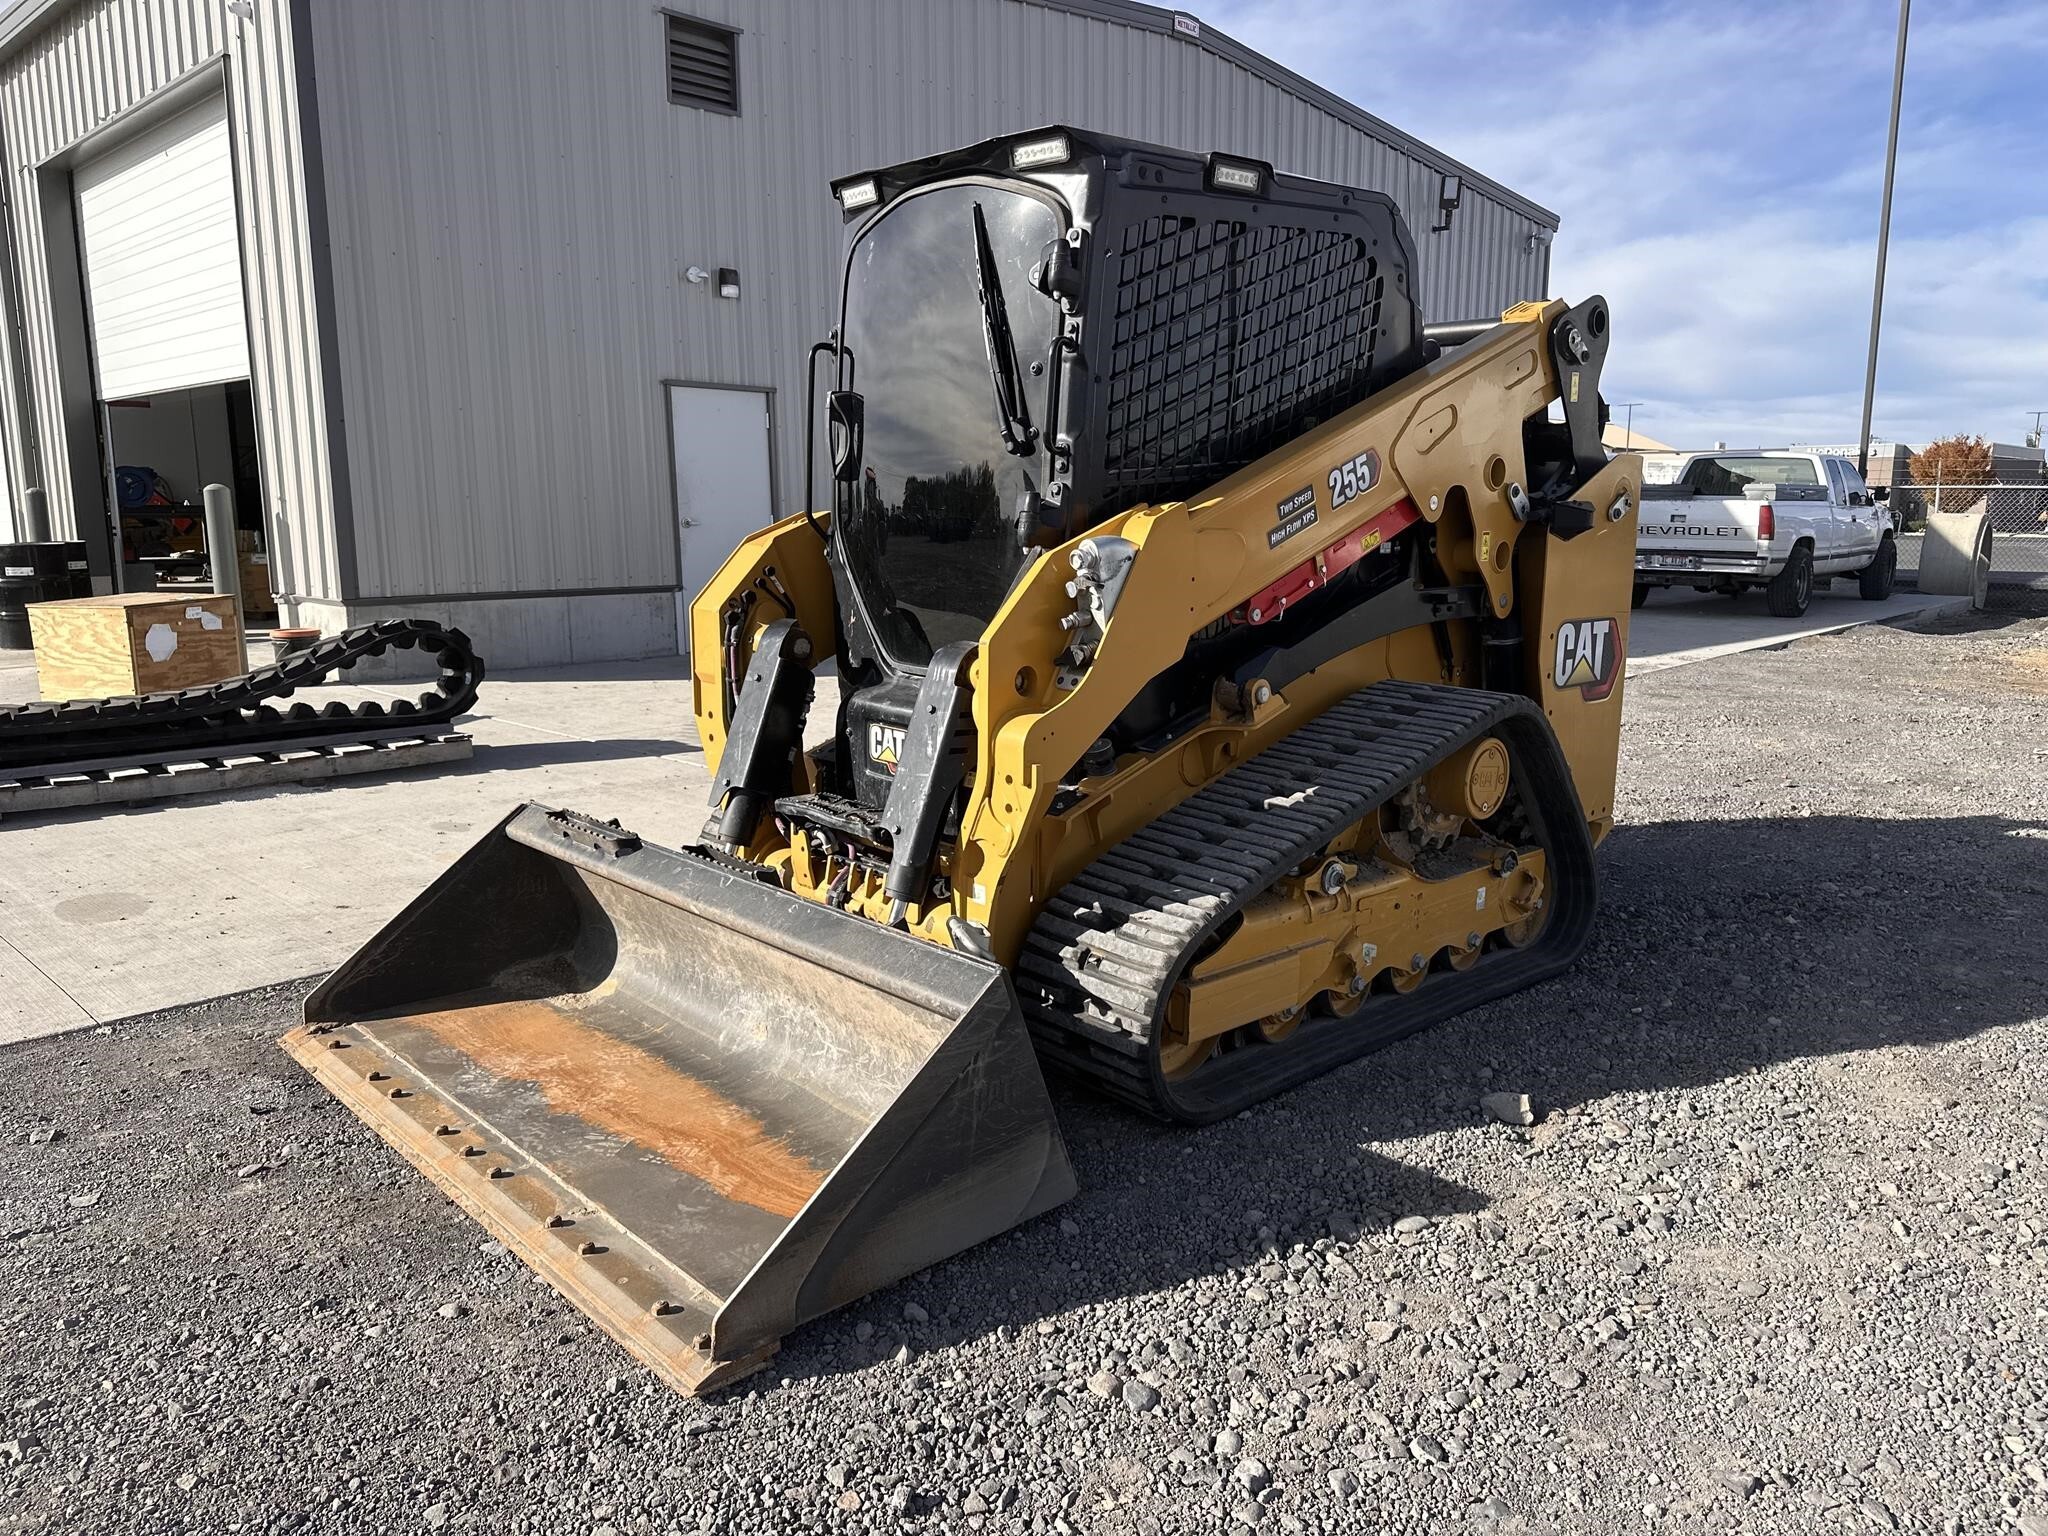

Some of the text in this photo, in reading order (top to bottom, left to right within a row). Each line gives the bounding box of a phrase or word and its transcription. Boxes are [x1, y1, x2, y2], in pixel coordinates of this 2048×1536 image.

[1329, 454, 1371, 509] 255
[1302, 509, 1315, 525] XPS
[1555, 620, 1610, 687] CAT
[870, 725, 906, 763] CAT
